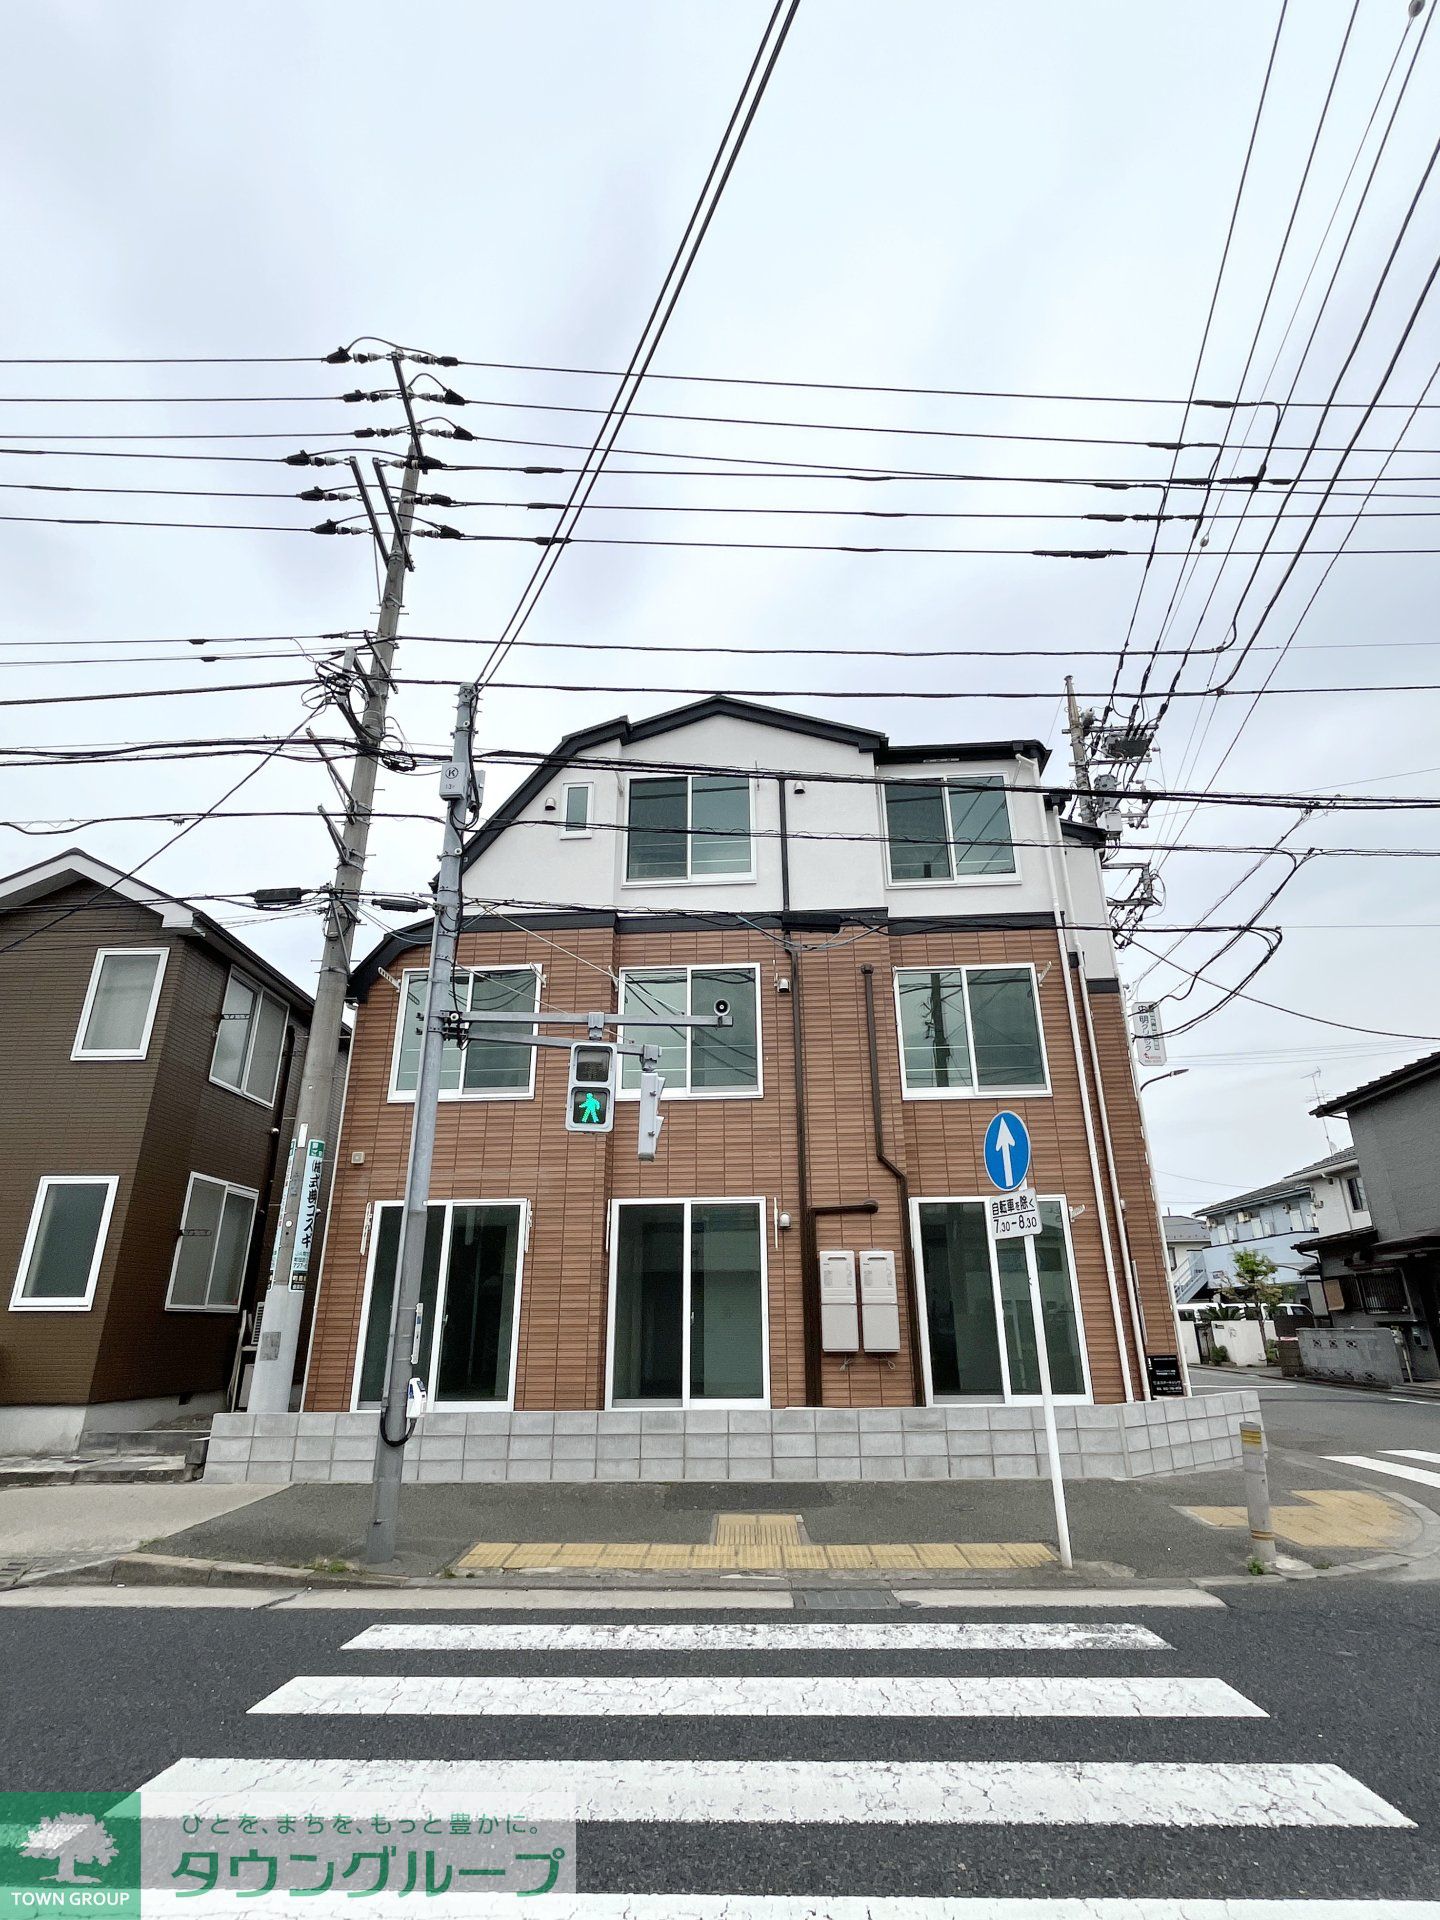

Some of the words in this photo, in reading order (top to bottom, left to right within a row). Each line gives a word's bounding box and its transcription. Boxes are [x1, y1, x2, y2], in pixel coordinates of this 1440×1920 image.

[992, 1195, 1035, 1215] 自転車を除く
